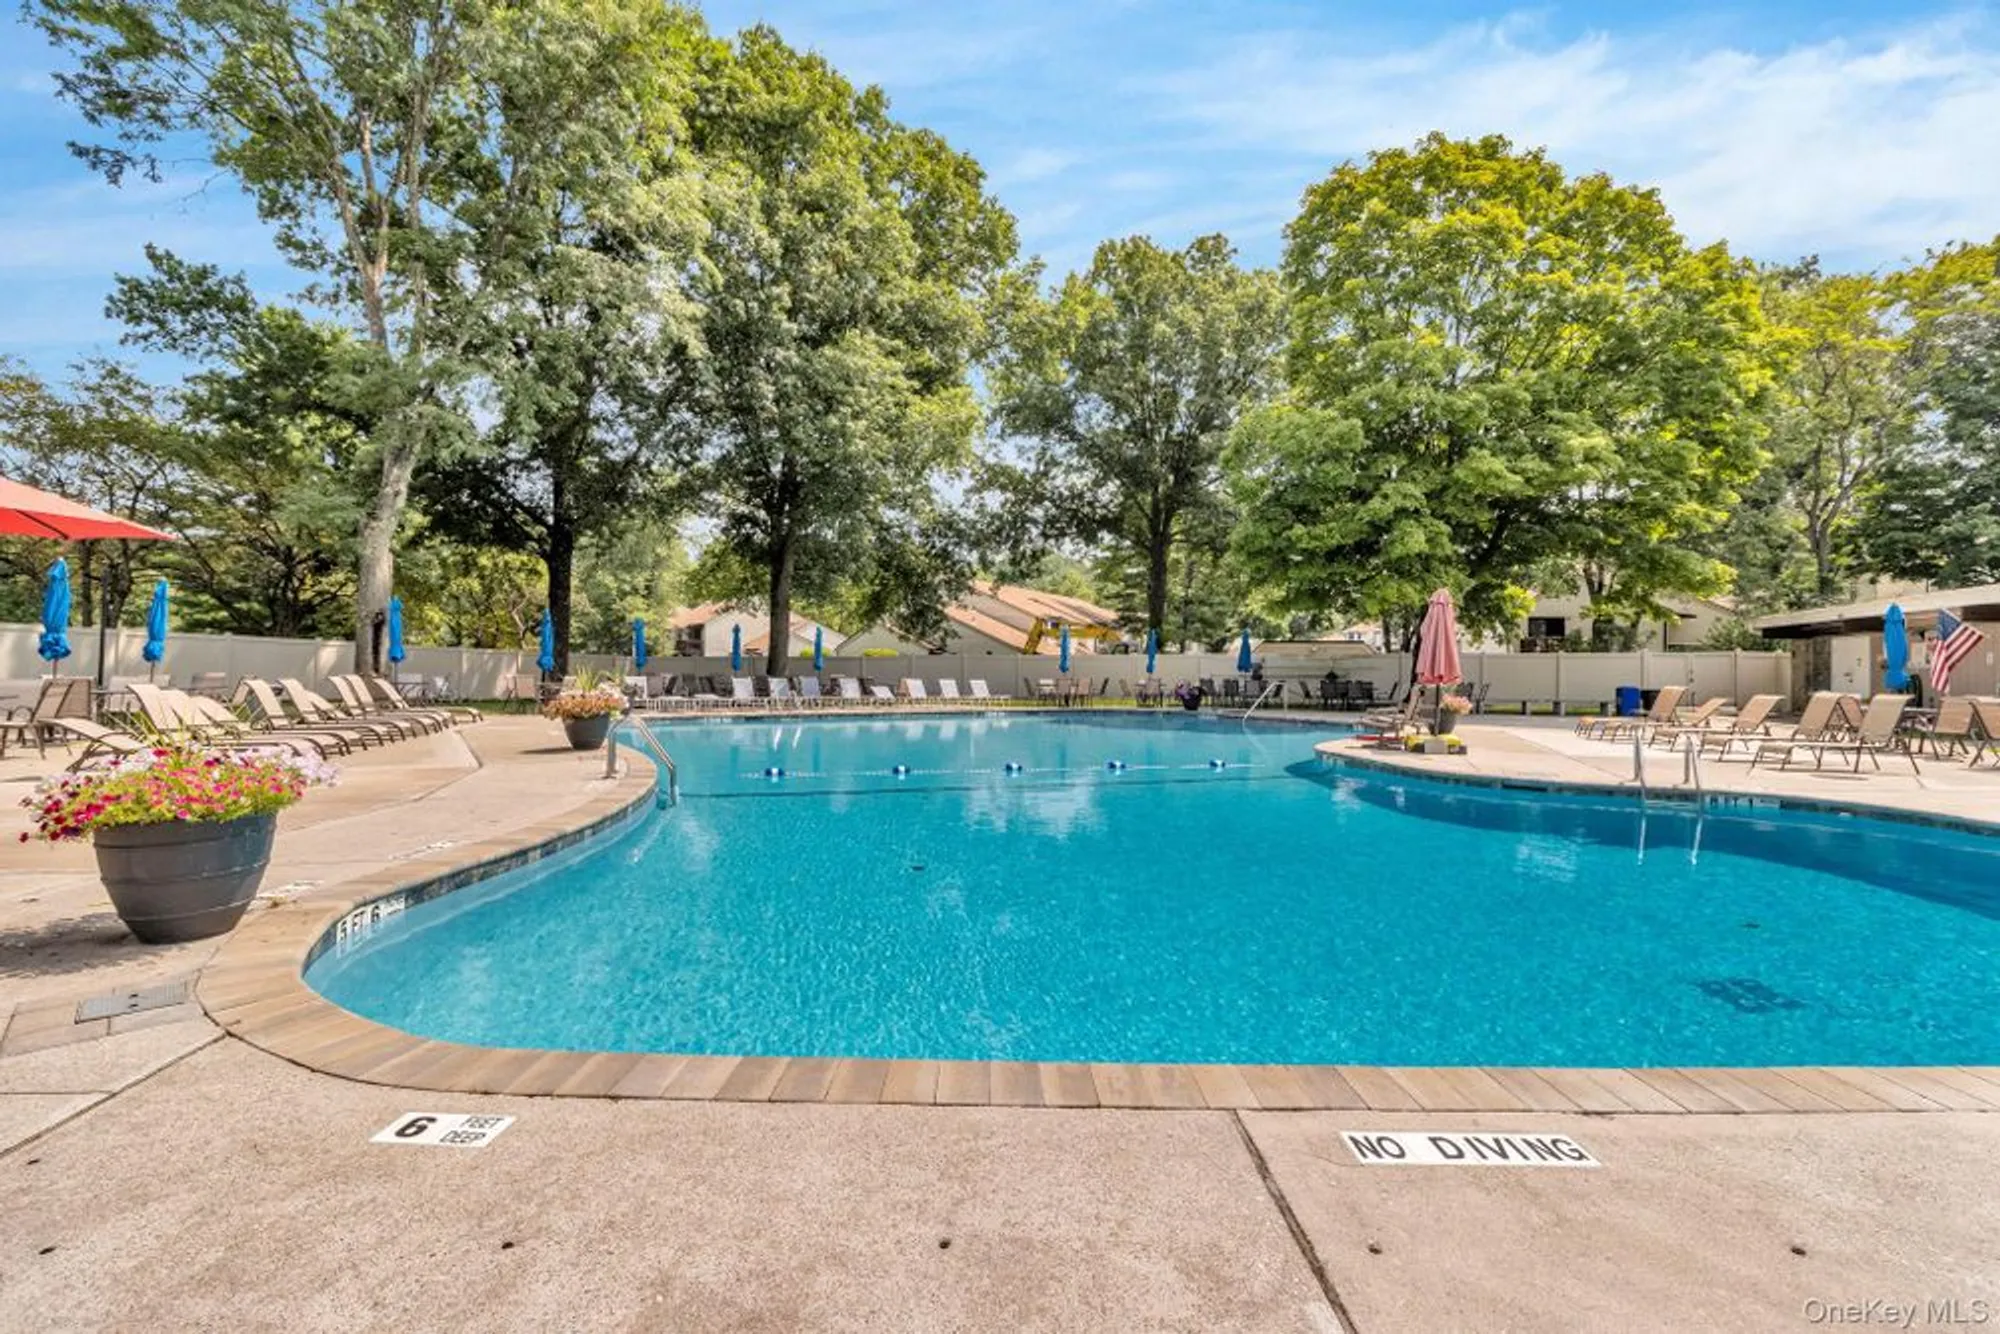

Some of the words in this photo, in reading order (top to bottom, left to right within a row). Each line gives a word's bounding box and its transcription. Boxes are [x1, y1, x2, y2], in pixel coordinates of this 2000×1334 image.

[394, 1116, 438, 1137] 6
[460, 1116, 505, 1129] FEET
[439, 1130, 488, 1143] DEEP
[1348, 1135, 1406, 1159] NO
[1427, 1136, 1590, 1162] DIVING
